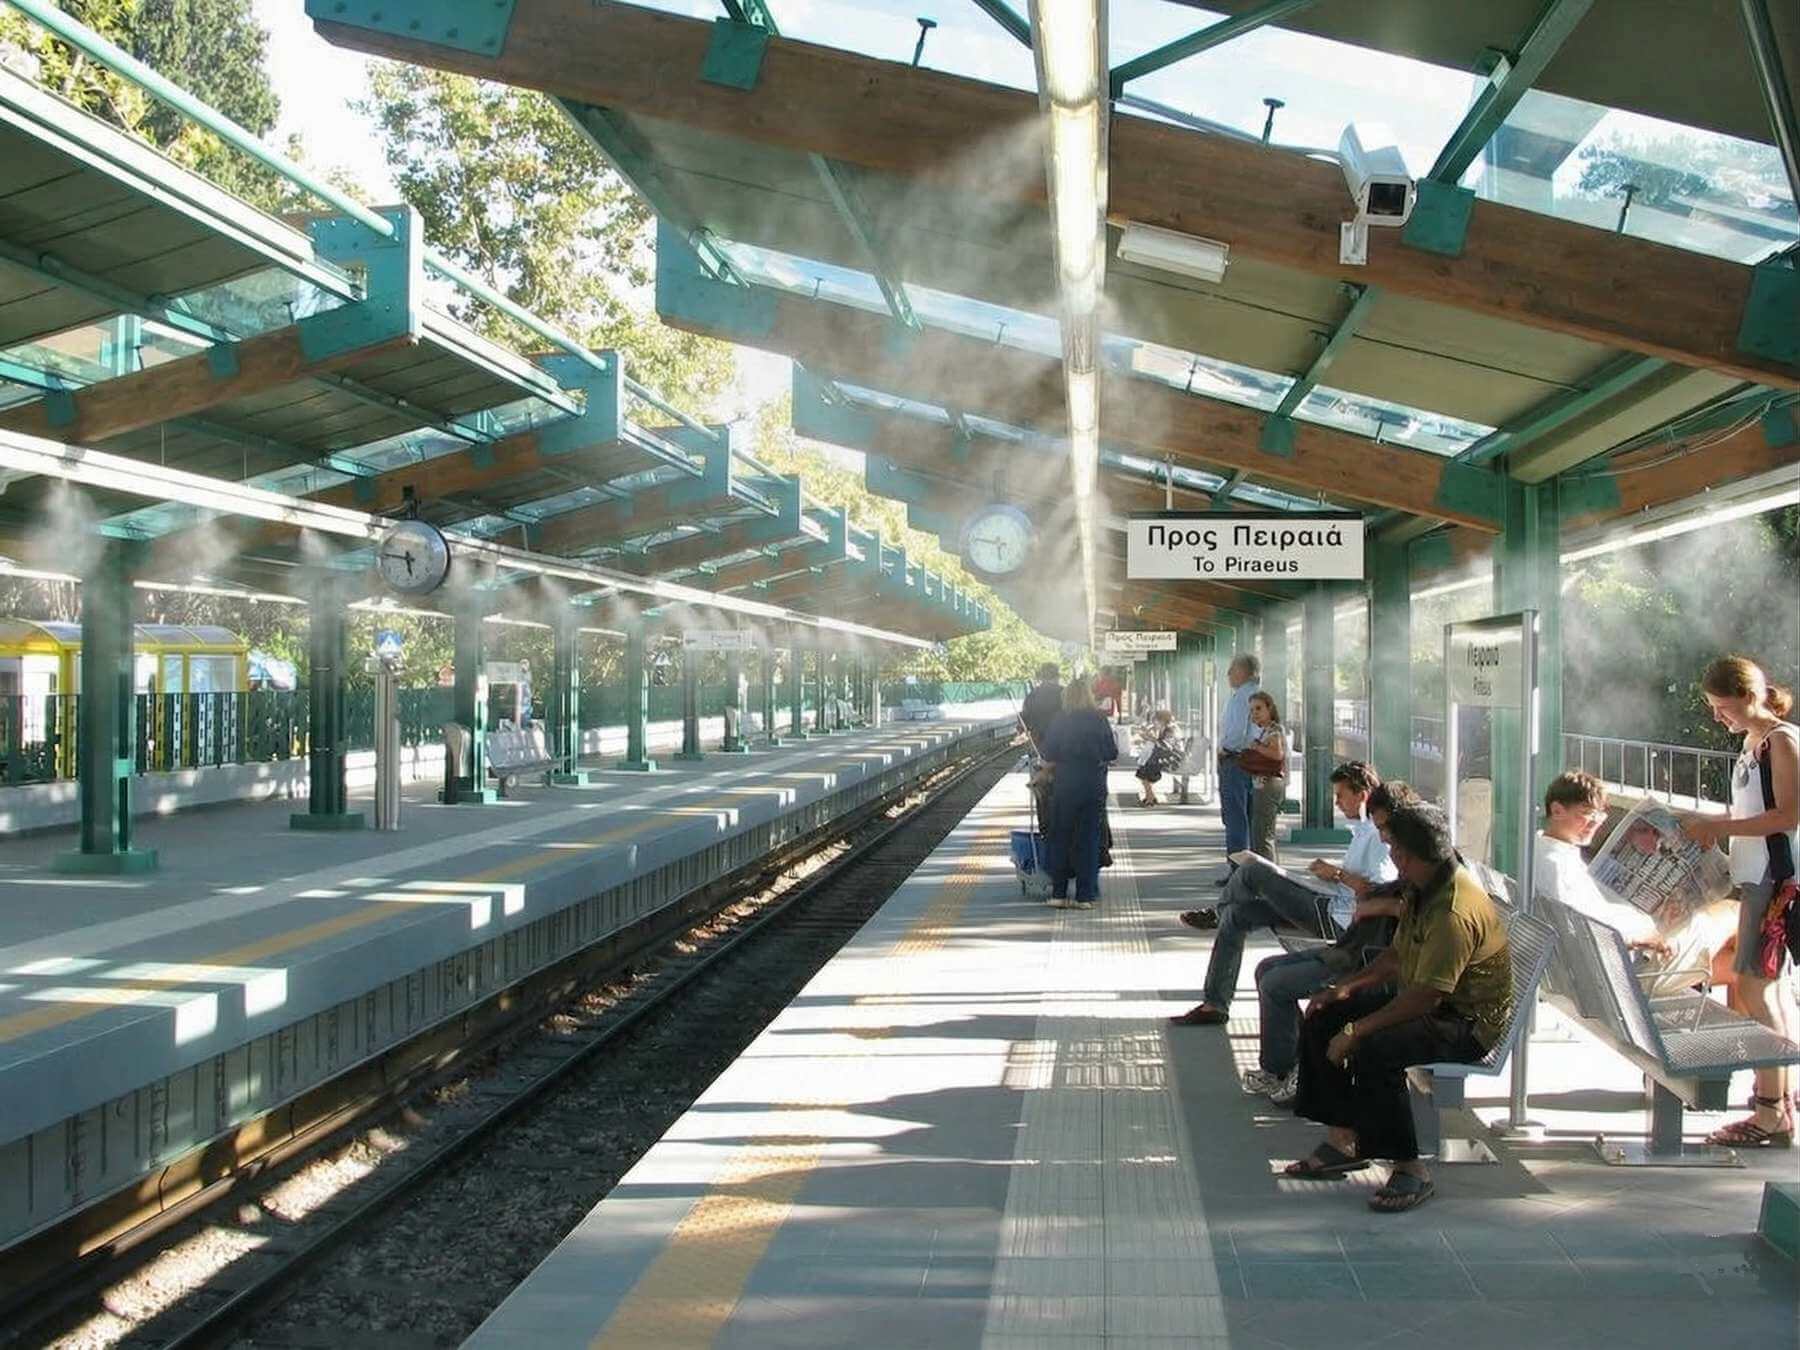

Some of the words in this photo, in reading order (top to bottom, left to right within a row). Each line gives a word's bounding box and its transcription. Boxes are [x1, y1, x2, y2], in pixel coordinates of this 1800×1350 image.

[1148, 525, 1217, 550] Προς
[1233, 524, 1343, 550] Πειραιά
[1193, 556, 1215, 572] To
[1225, 556, 1299, 572] Piraeus
